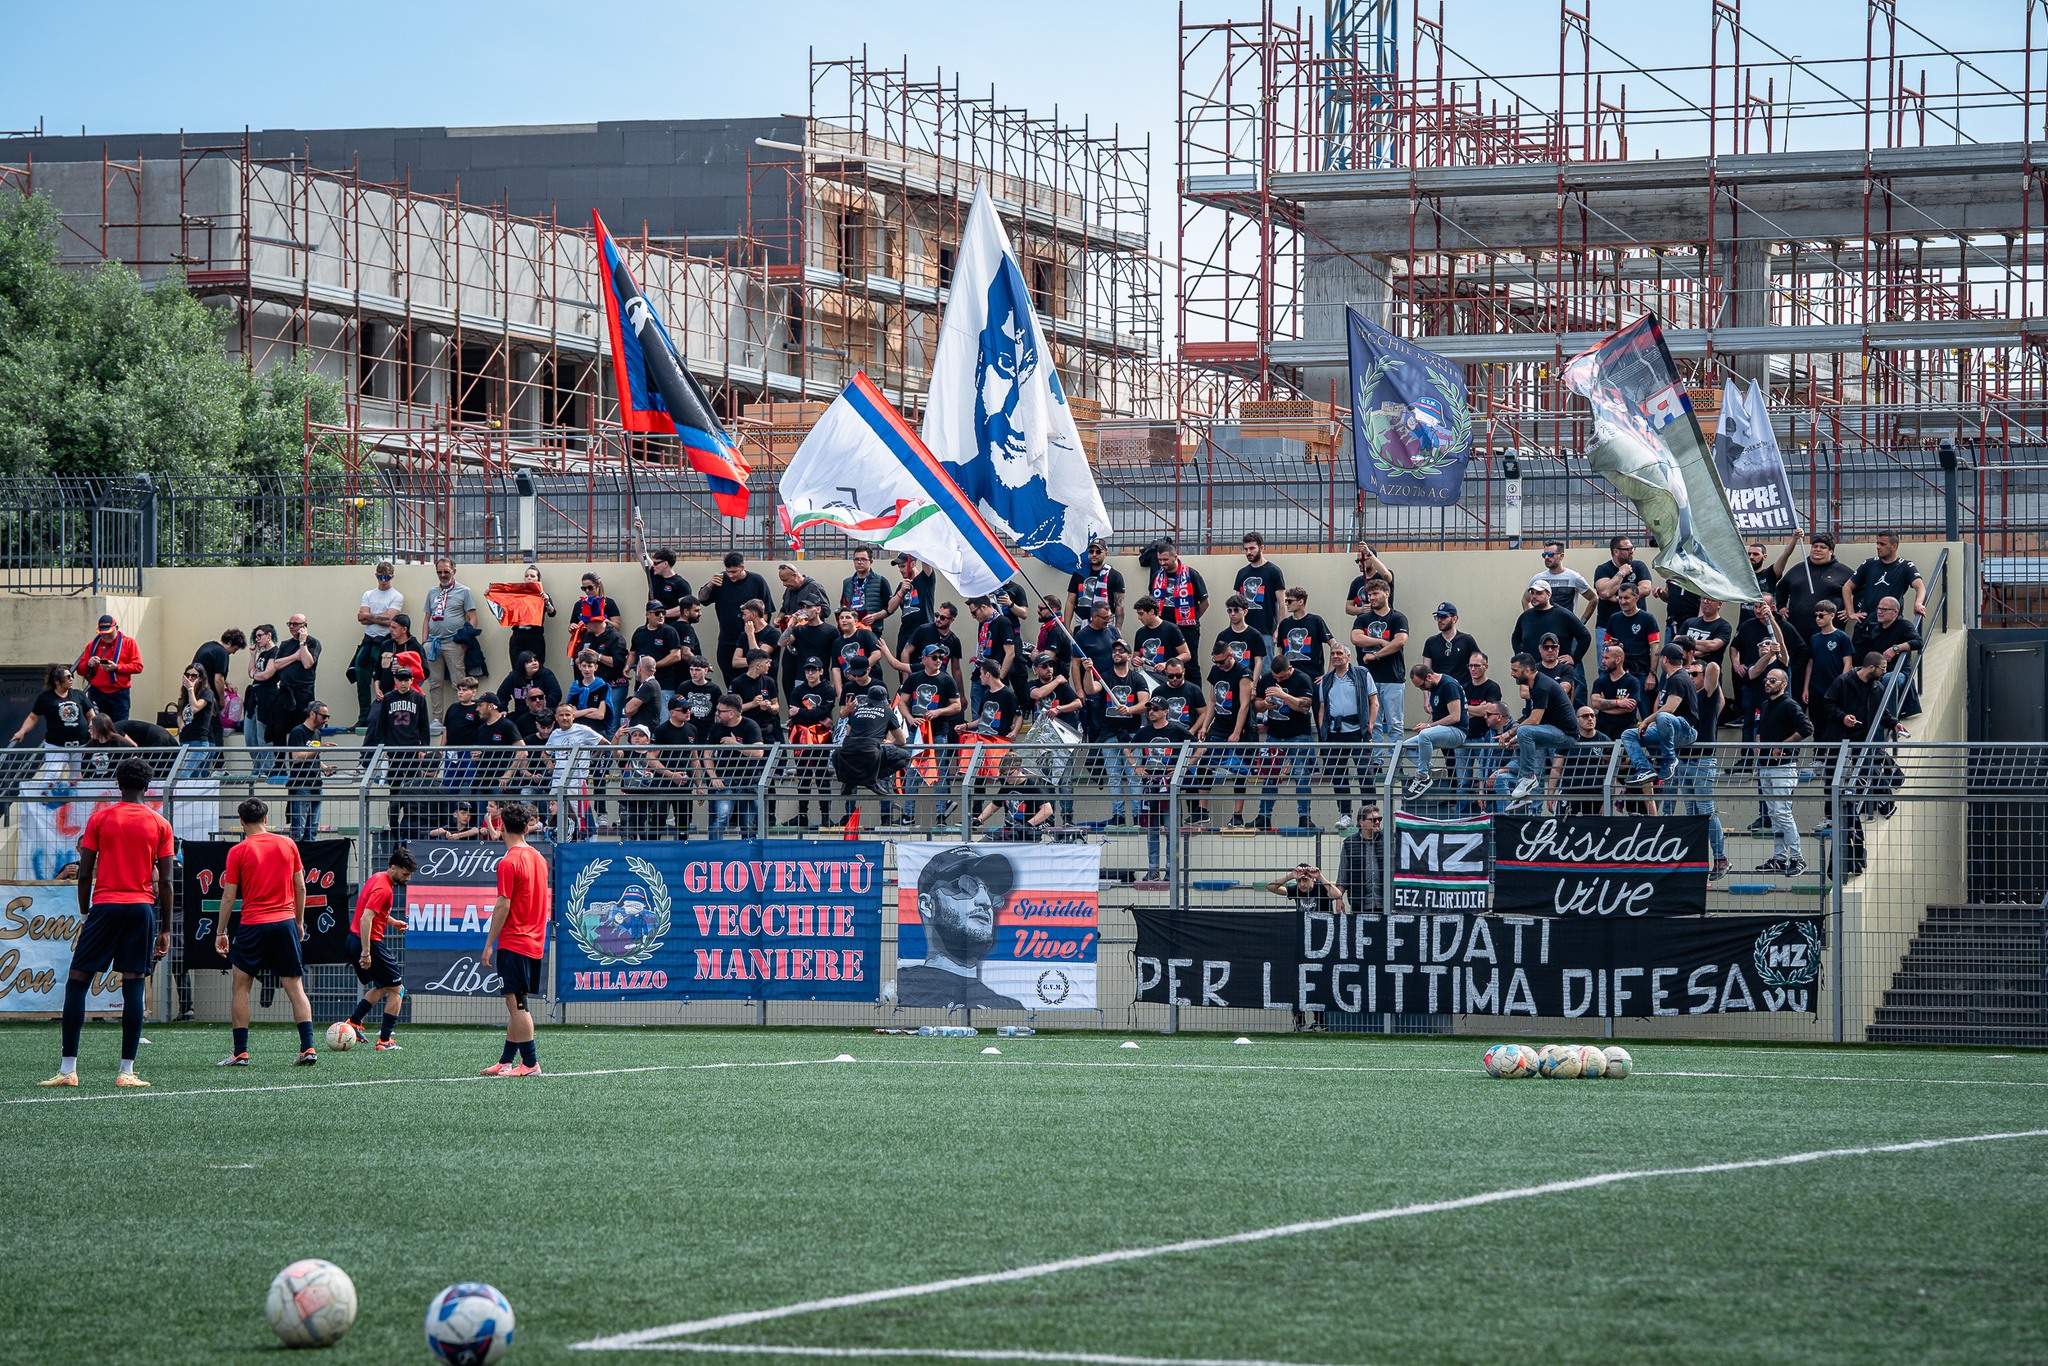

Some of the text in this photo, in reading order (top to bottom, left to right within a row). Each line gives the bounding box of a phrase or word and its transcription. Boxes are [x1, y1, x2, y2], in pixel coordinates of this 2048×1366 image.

[388, 700, 417, 714] JORDAN
[394, 711, 411, 726] 23
[1400, 831, 1484, 873] MZ
[683, 854, 875, 893] GIOVENTÙ
[1013, 897, 1094, 921] Spisidda
[1395, 888, 1486, 909] SEZ. FLORIDIA
[692, 904, 855, 937] VECCHIE
[1013, 929, 1094, 959] Vive!
[1304, 912, 1550, 964] DIFFIDATI
[693, 948, 864, 981] MANIERE
[1768, 944, 1808, 968] MZ
[574, 970, 668, 990] MILAZZO
[1137, 956, 1757, 1018] PER LEGITTIMA DIFESA
